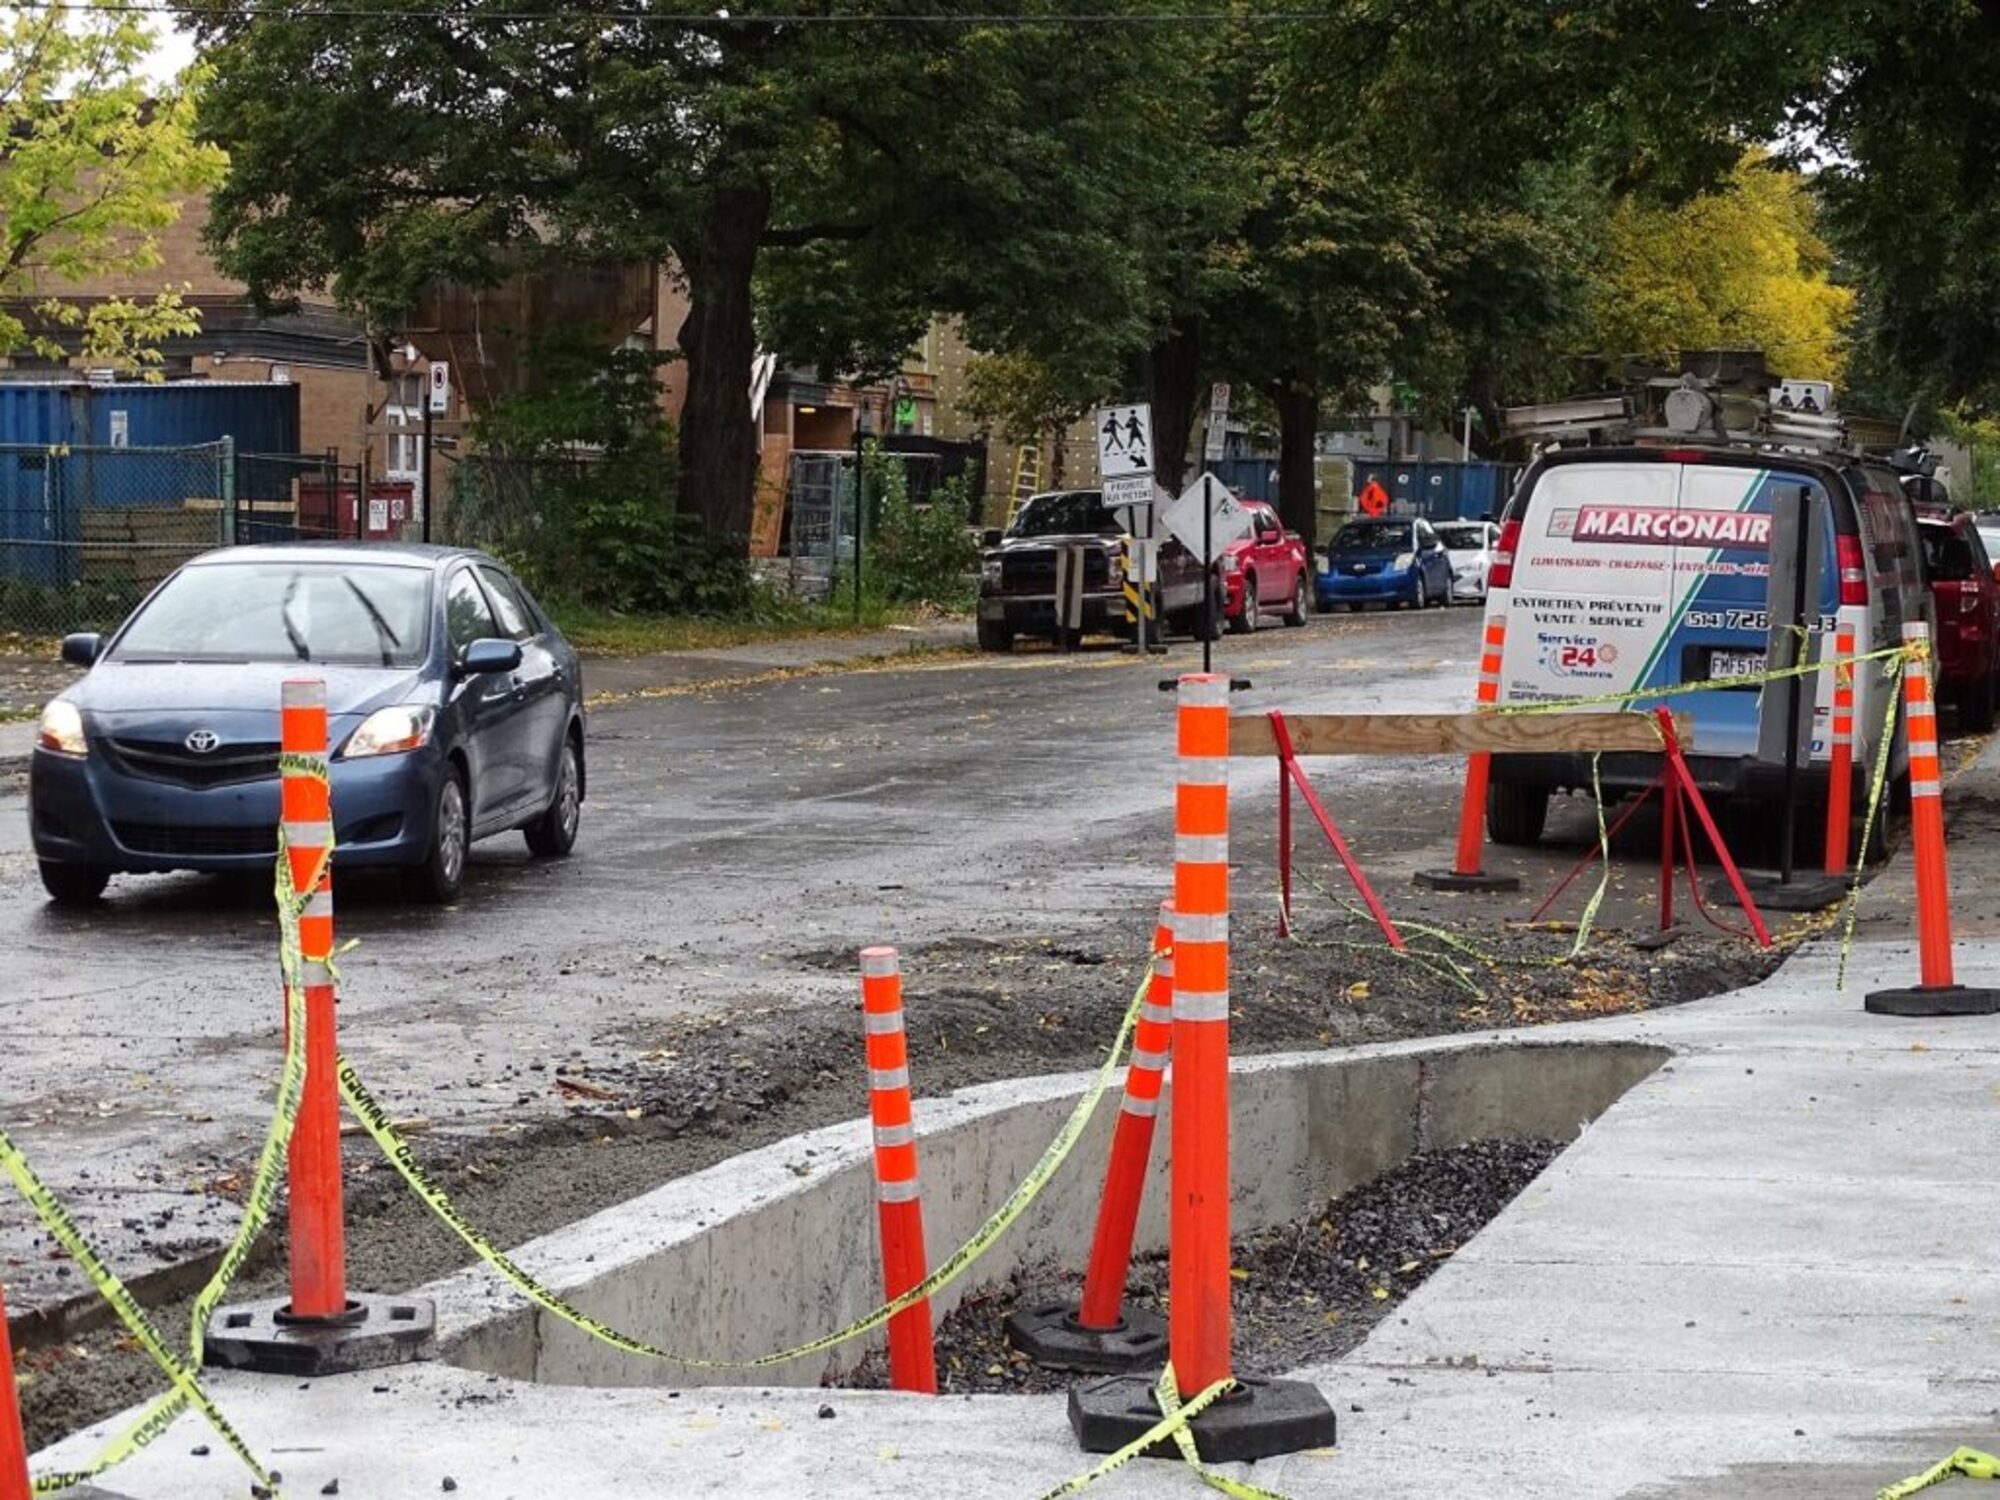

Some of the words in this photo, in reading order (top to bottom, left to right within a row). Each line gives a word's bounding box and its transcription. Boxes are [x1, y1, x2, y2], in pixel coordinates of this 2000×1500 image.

[1579, 511, 1771, 543] MARCONAIR
[1512, 597, 1585, 610] ENTRETIEN
[1534, 613, 1577, 625] VENTE
[1589, 616, 1646, 628] SERVICE
[1538, 632, 1598, 645] Service
[1562, 646, 1597, 668] 24
